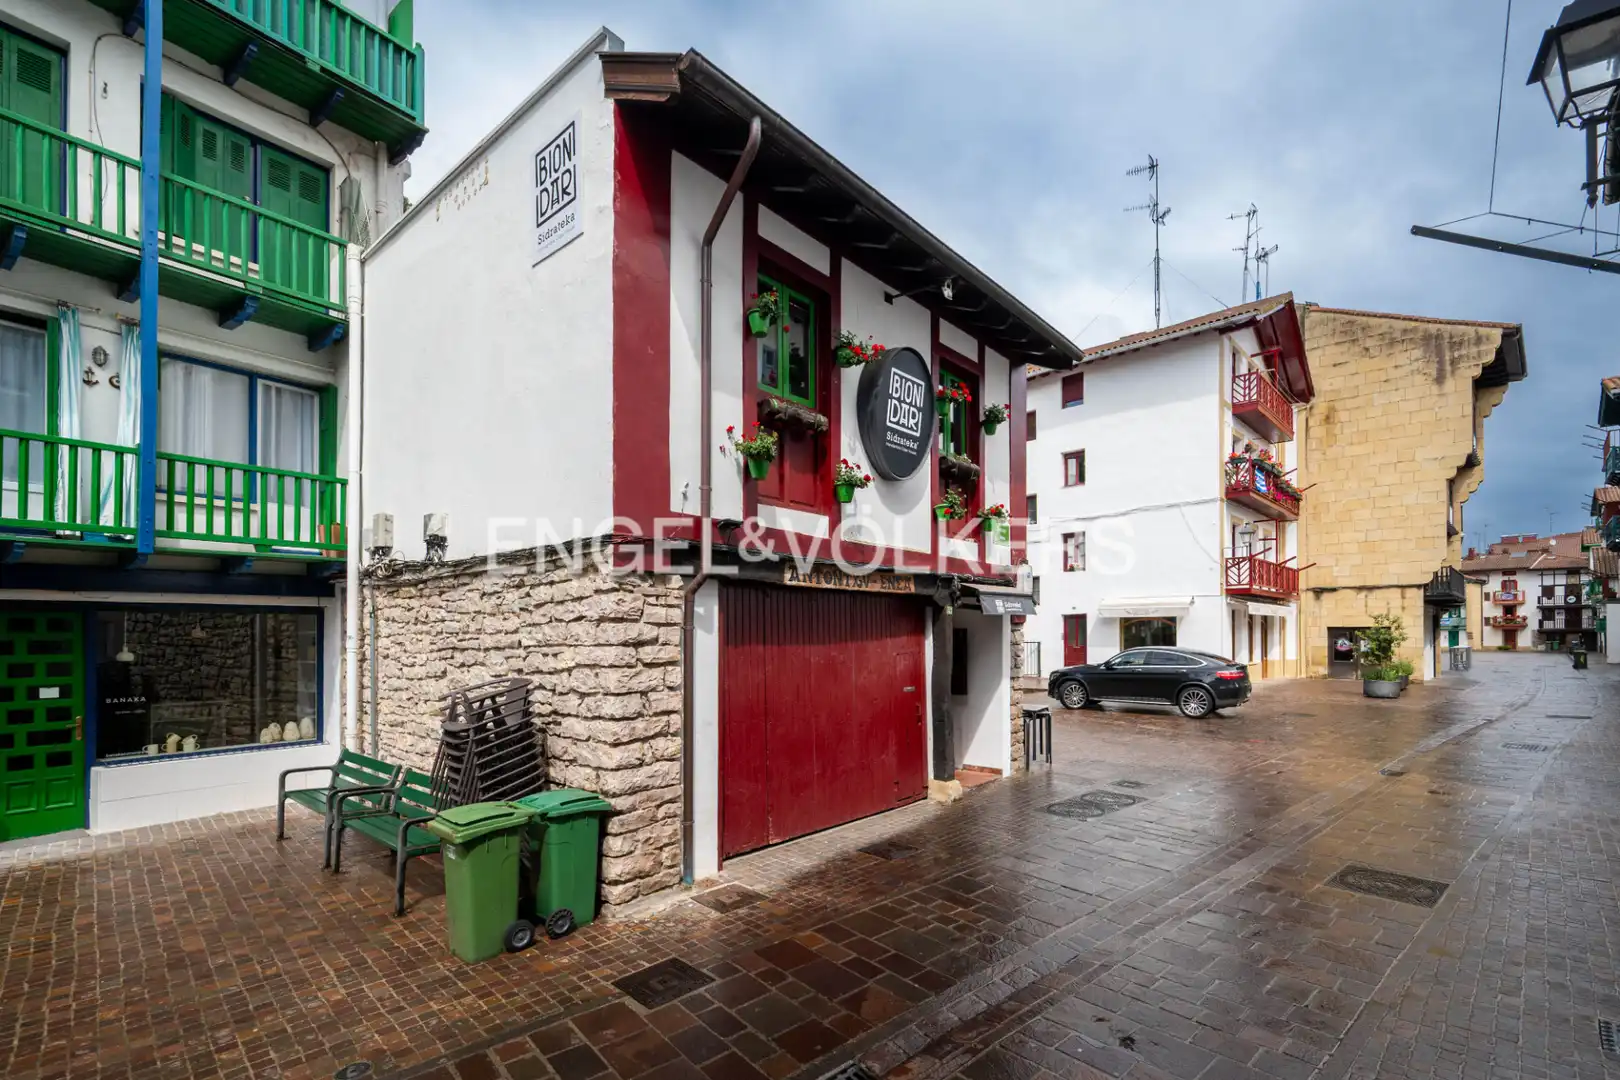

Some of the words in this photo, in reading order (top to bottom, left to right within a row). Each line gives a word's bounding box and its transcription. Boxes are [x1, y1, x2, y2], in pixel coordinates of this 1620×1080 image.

[539, 131, 572, 187] BION
[539, 168, 573, 219] DAR
[537, 213, 575, 245] Sidrateka
[892, 374, 922, 408] BION
[889, 398, 919, 431] DAR
[886, 431, 918, 450] Sidrateka
